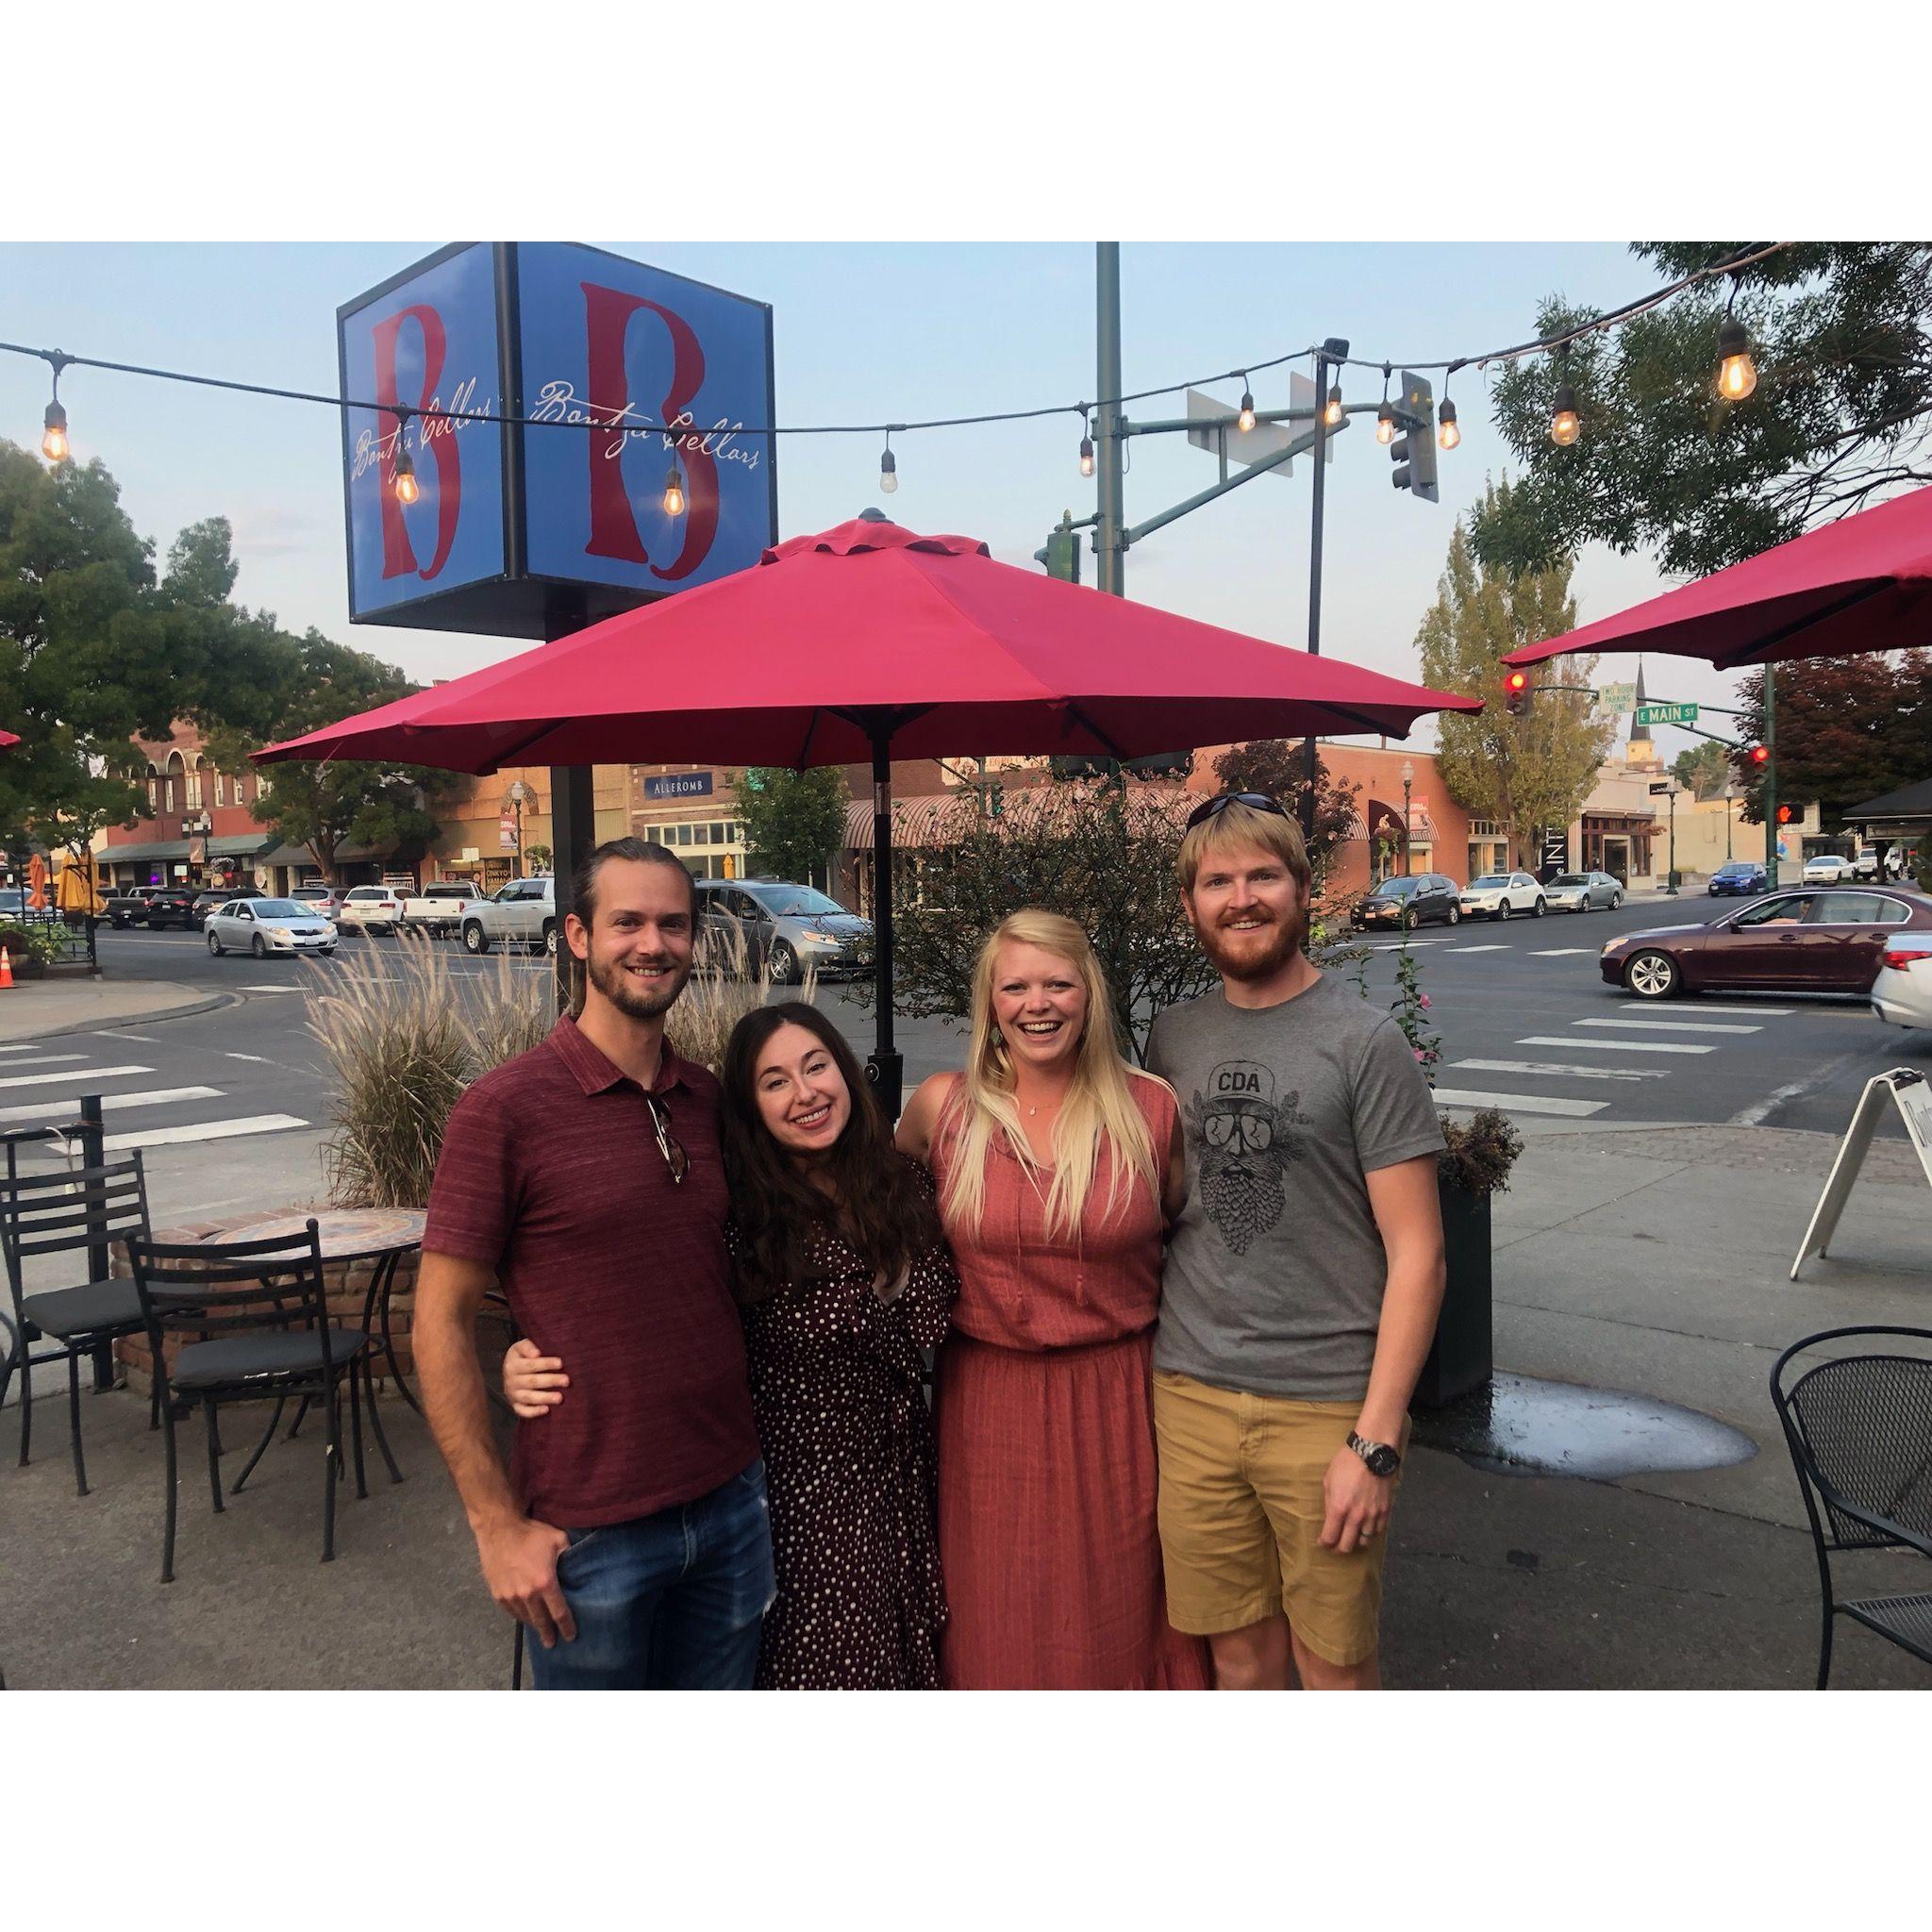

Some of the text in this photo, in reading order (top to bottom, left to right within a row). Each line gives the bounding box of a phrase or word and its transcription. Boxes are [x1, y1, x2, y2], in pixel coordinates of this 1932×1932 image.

[421, 376, 491, 450] Cellars
[662, 411, 760, 470] Cellars
[1617, 685, 1635, 693] HOUR
[1605, 693, 1631, 704] PARKING
[1609, 703, 1626, 712] ZONE
[1641, 707, 1695, 723] E MAIN ST
[1218, 1072, 1260, 1092] CDA
